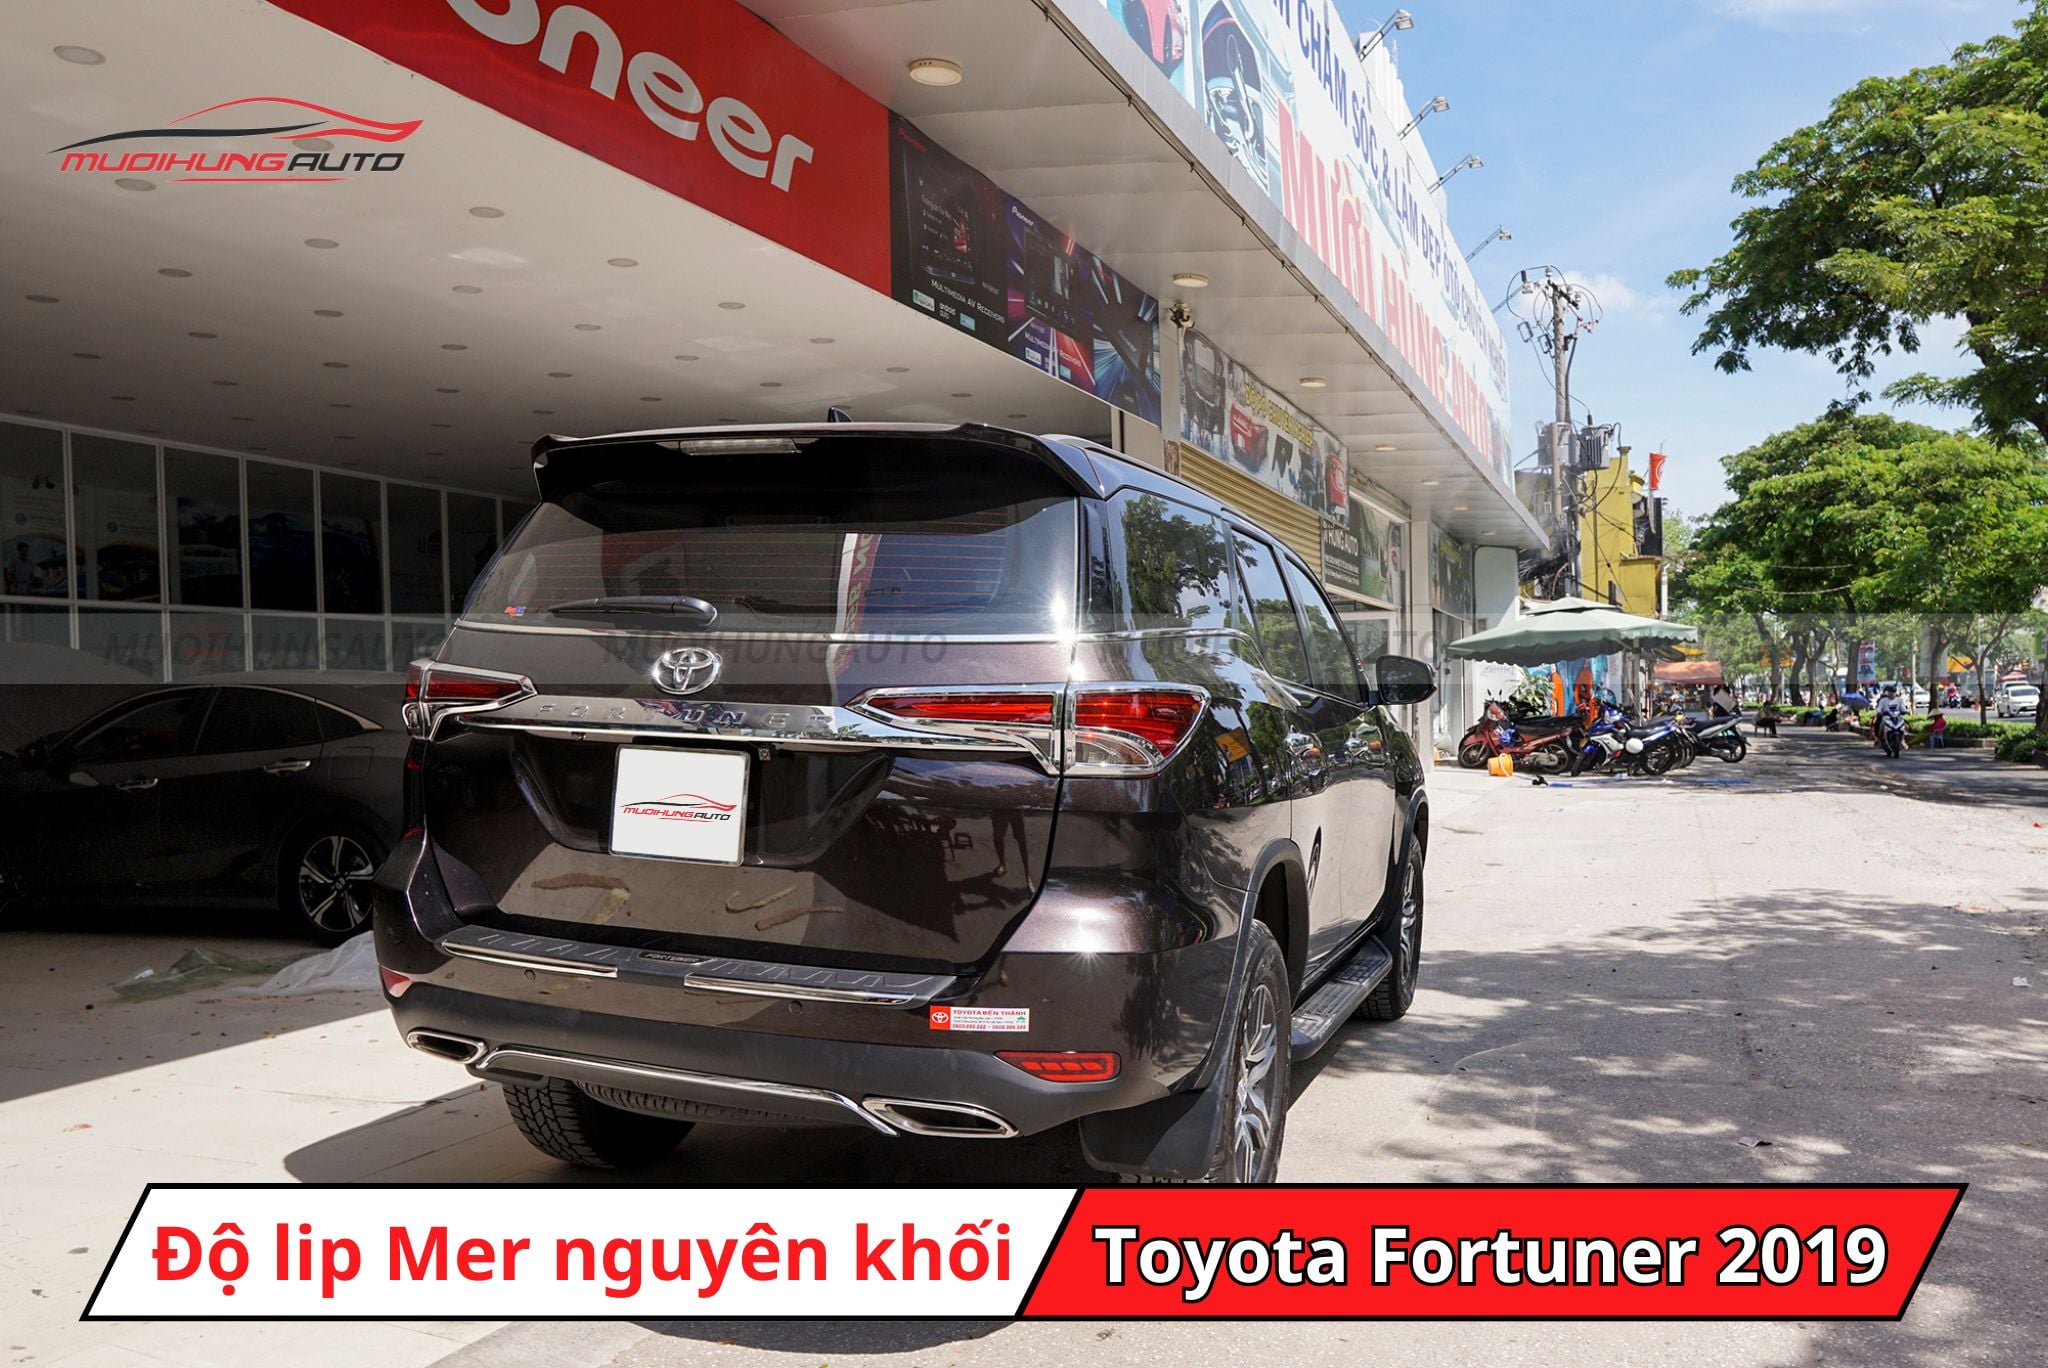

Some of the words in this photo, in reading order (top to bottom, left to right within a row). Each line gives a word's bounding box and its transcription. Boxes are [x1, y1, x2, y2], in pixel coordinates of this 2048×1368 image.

[1352, 90, 1379, 180] SÓC
[1383, 148, 1392, 202] &
[1395, 164, 1419, 248] LÀM
[1421, 212, 1442, 280] ĐẸP
[1381, 250, 1449, 406] HÙNG
[534, 702, 836, 729] FORTUNER
